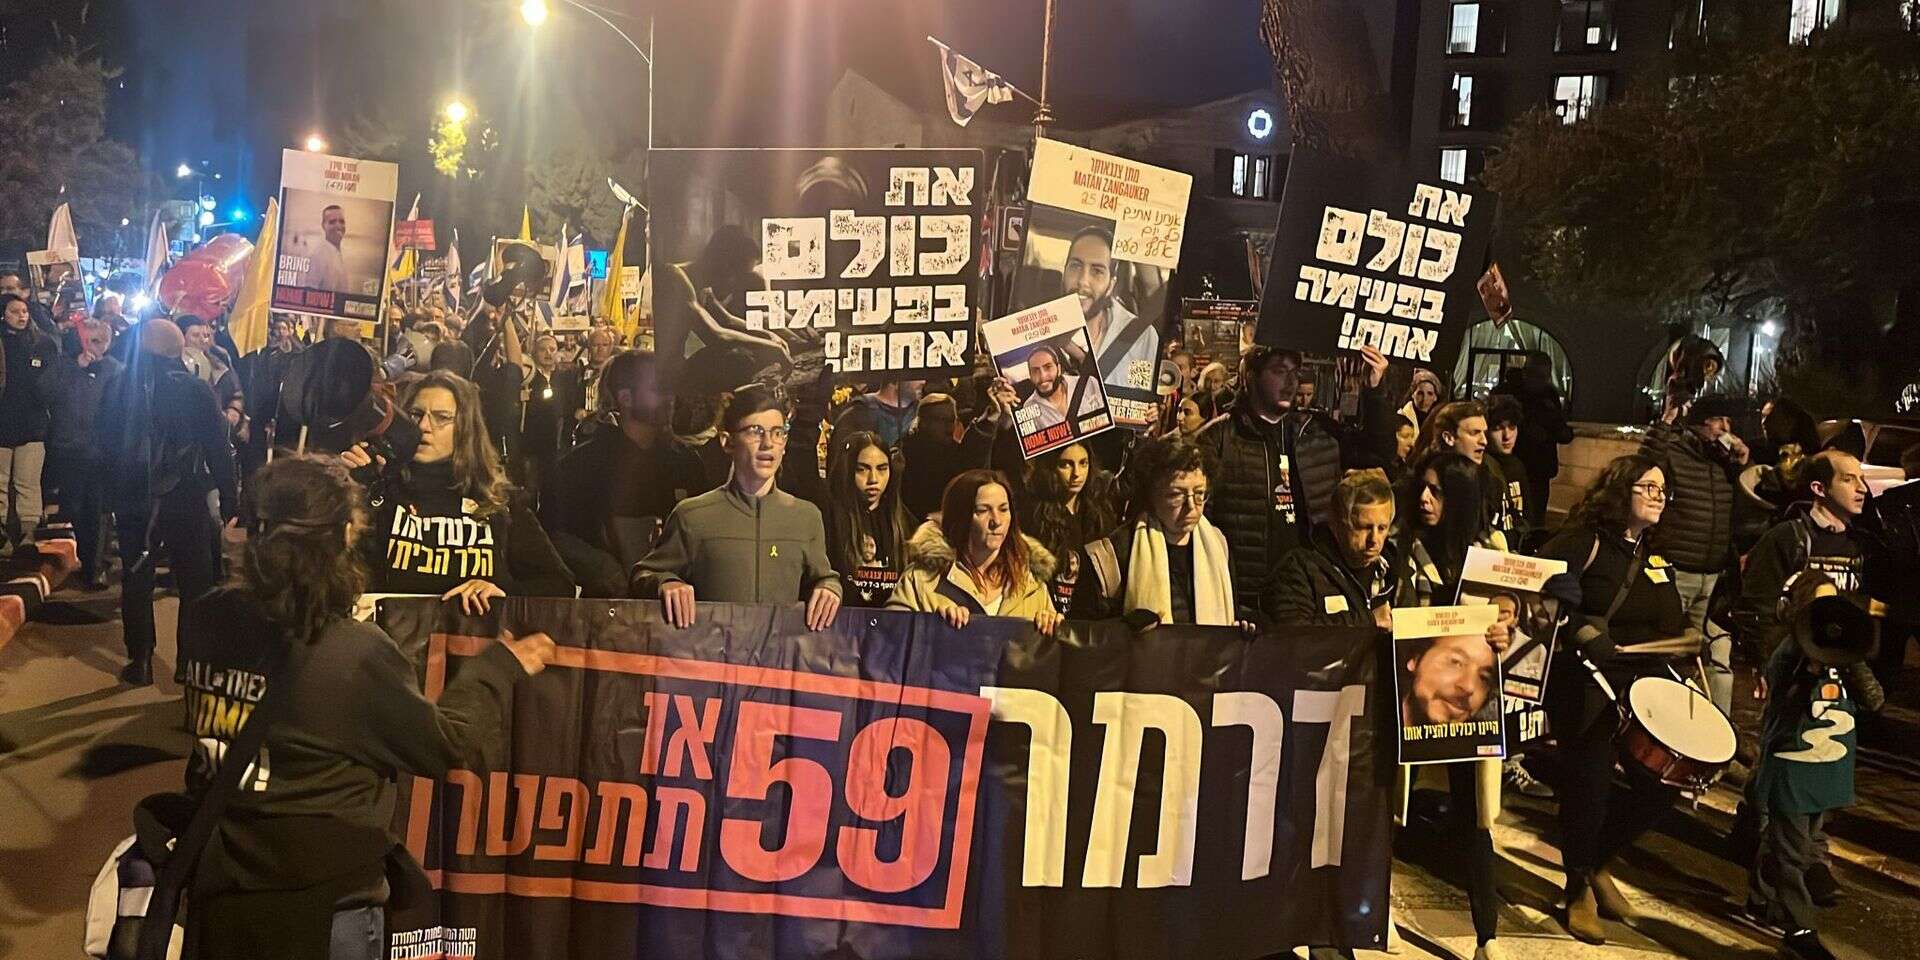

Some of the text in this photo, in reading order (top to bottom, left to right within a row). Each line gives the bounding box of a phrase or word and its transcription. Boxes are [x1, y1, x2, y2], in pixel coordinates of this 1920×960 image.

[885, 166, 974, 206] את
[1073, 171, 1150, 203] MATAN ZANGAUKER
[1124, 167, 1140, 183] מתן
[1155, 211, 1181, 227] אנחנו
[1408, 184, 1472, 227] את
[762, 209, 972, 282] כולם
[1316, 206, 1462, 283] כולם
[278, 270, 298, 287] HIM
[279, 254, 311, 273] BRING
[744, 284, 969, 332] בפעימה
[1295, 265, 1445, 324] בפעימה
[825, 330, 967, 374] אחת!
[1338, 313, 1438, 362] אחת!
[1015, 402, 1041, 423] BRING
[1019, 419, 1037, 437] HIM
[1024, 430, 1048, 450] HOME
[1046, 420, 1073, 442] NOW!
[455, 547, 494, 577] הלך
[640, 692, 723, 781] או
[1403, 720, 1499, 741] היינו יכולים להציל אותו
[720, 684, 1365, 893] דרמר 59
[446, 770, 706, 872] תתפטר
[391, 928, 424, 946] להחזרת
[458, 927, 476, 941] מטה
